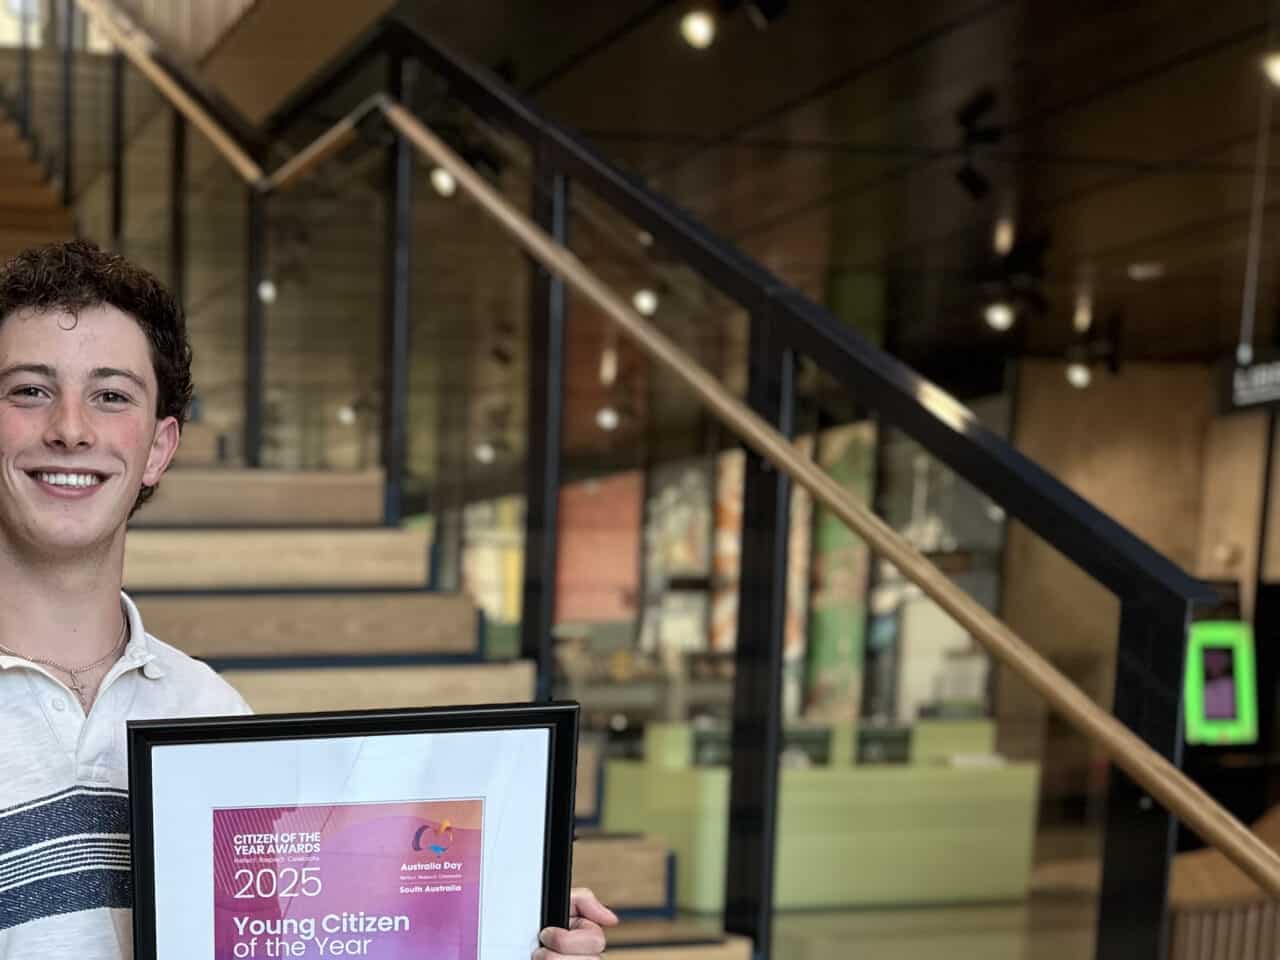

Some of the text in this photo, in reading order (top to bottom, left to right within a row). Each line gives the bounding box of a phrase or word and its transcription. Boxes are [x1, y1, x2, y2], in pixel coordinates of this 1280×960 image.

[233, 831, 321, 845] CITIZEN OF THE
[233, 842, 321, 855] YEAR AWARDS
[400, 861, 462, 871] Australia Day
[233, 867, 322, 899] 2025
[400, 884, 462, 894] South Australia
[233, 911, 410, 940] Young Citizen
[233, 936, 372, 958] of the Year
